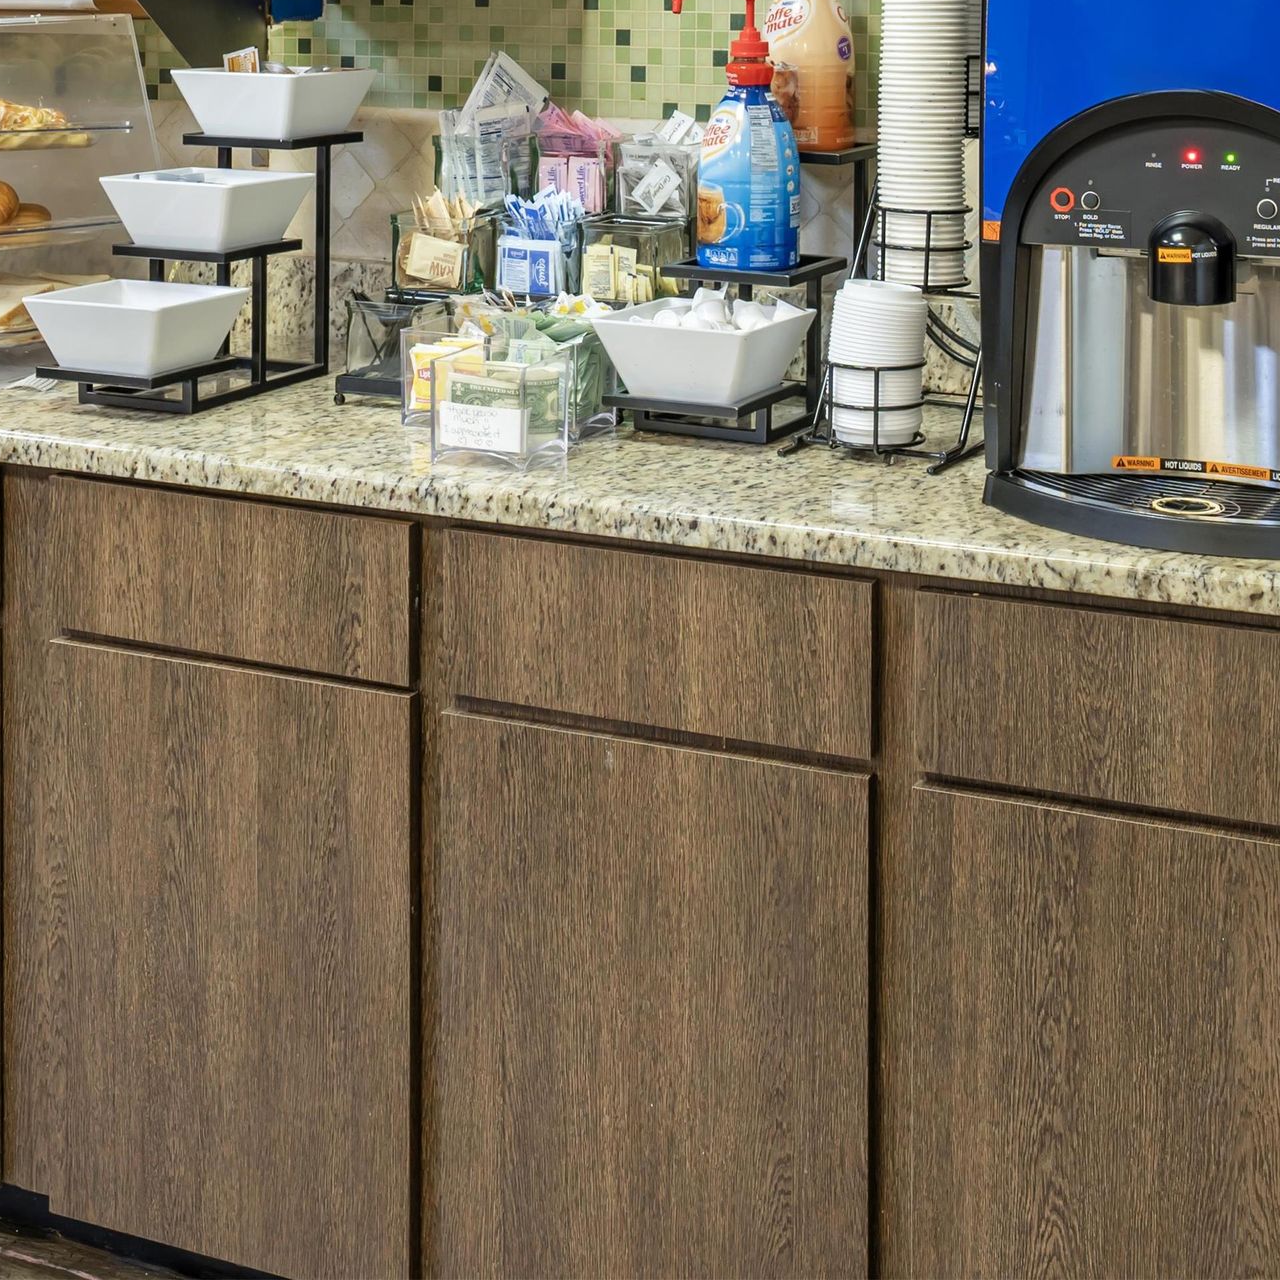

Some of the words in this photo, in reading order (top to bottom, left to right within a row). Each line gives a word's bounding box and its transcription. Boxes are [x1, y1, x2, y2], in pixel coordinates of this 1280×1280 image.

[766, 15, 803, 34] mate
[1253, 223, 1280, 231] REGULAR
[538, 257, 549, 287] equal
[1127, 459, 1154, 468] WARNING
[1164, 461, 1178, 469] HOT
[1178, 461, 1202, 471] LIQUIDS
[1221, 465, 1267, 478] AVERTISSEMENT
